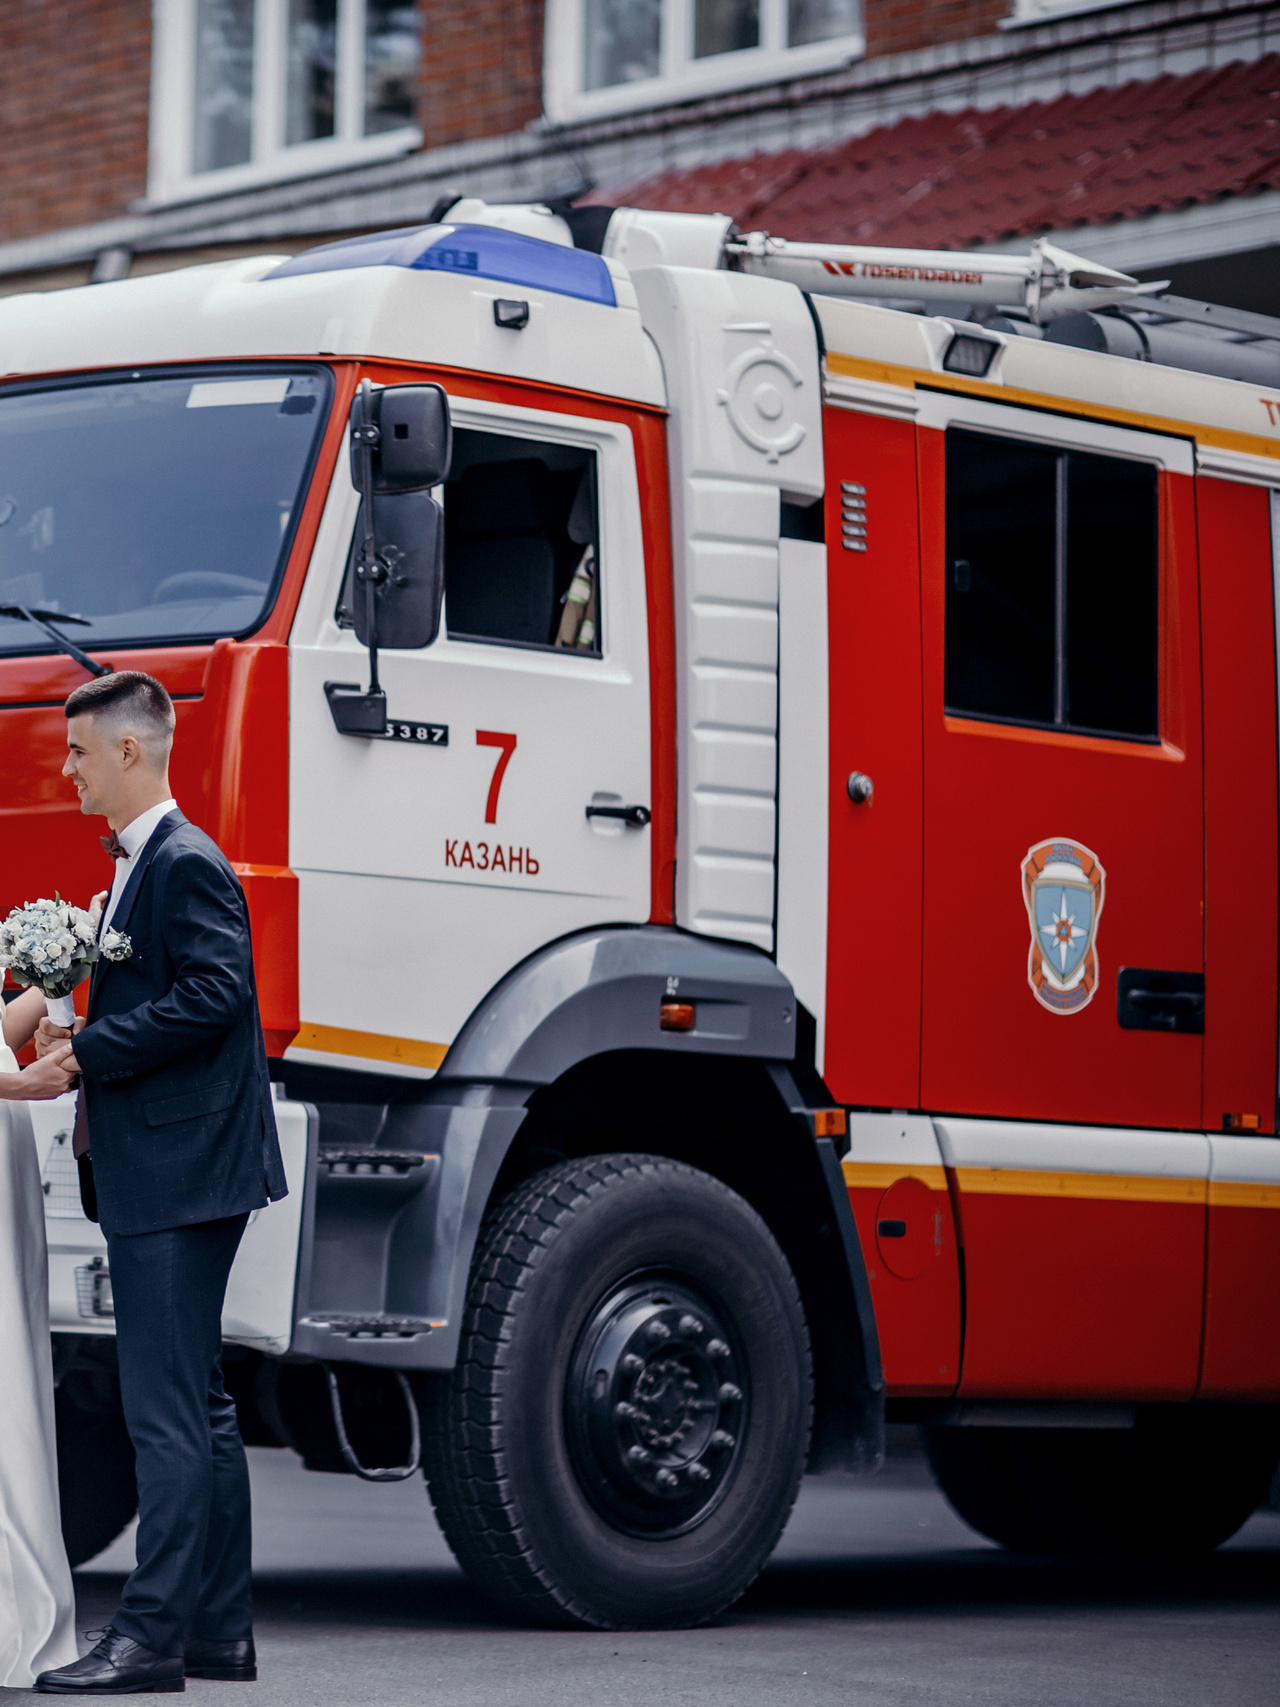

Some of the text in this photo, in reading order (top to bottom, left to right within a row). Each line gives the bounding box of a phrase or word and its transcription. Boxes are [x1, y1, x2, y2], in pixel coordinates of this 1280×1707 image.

[385, 724, 445, 742] 5387
[476, 729, 517, 824] 7
[445, 838, 540, 875] КАЗАНЬ
